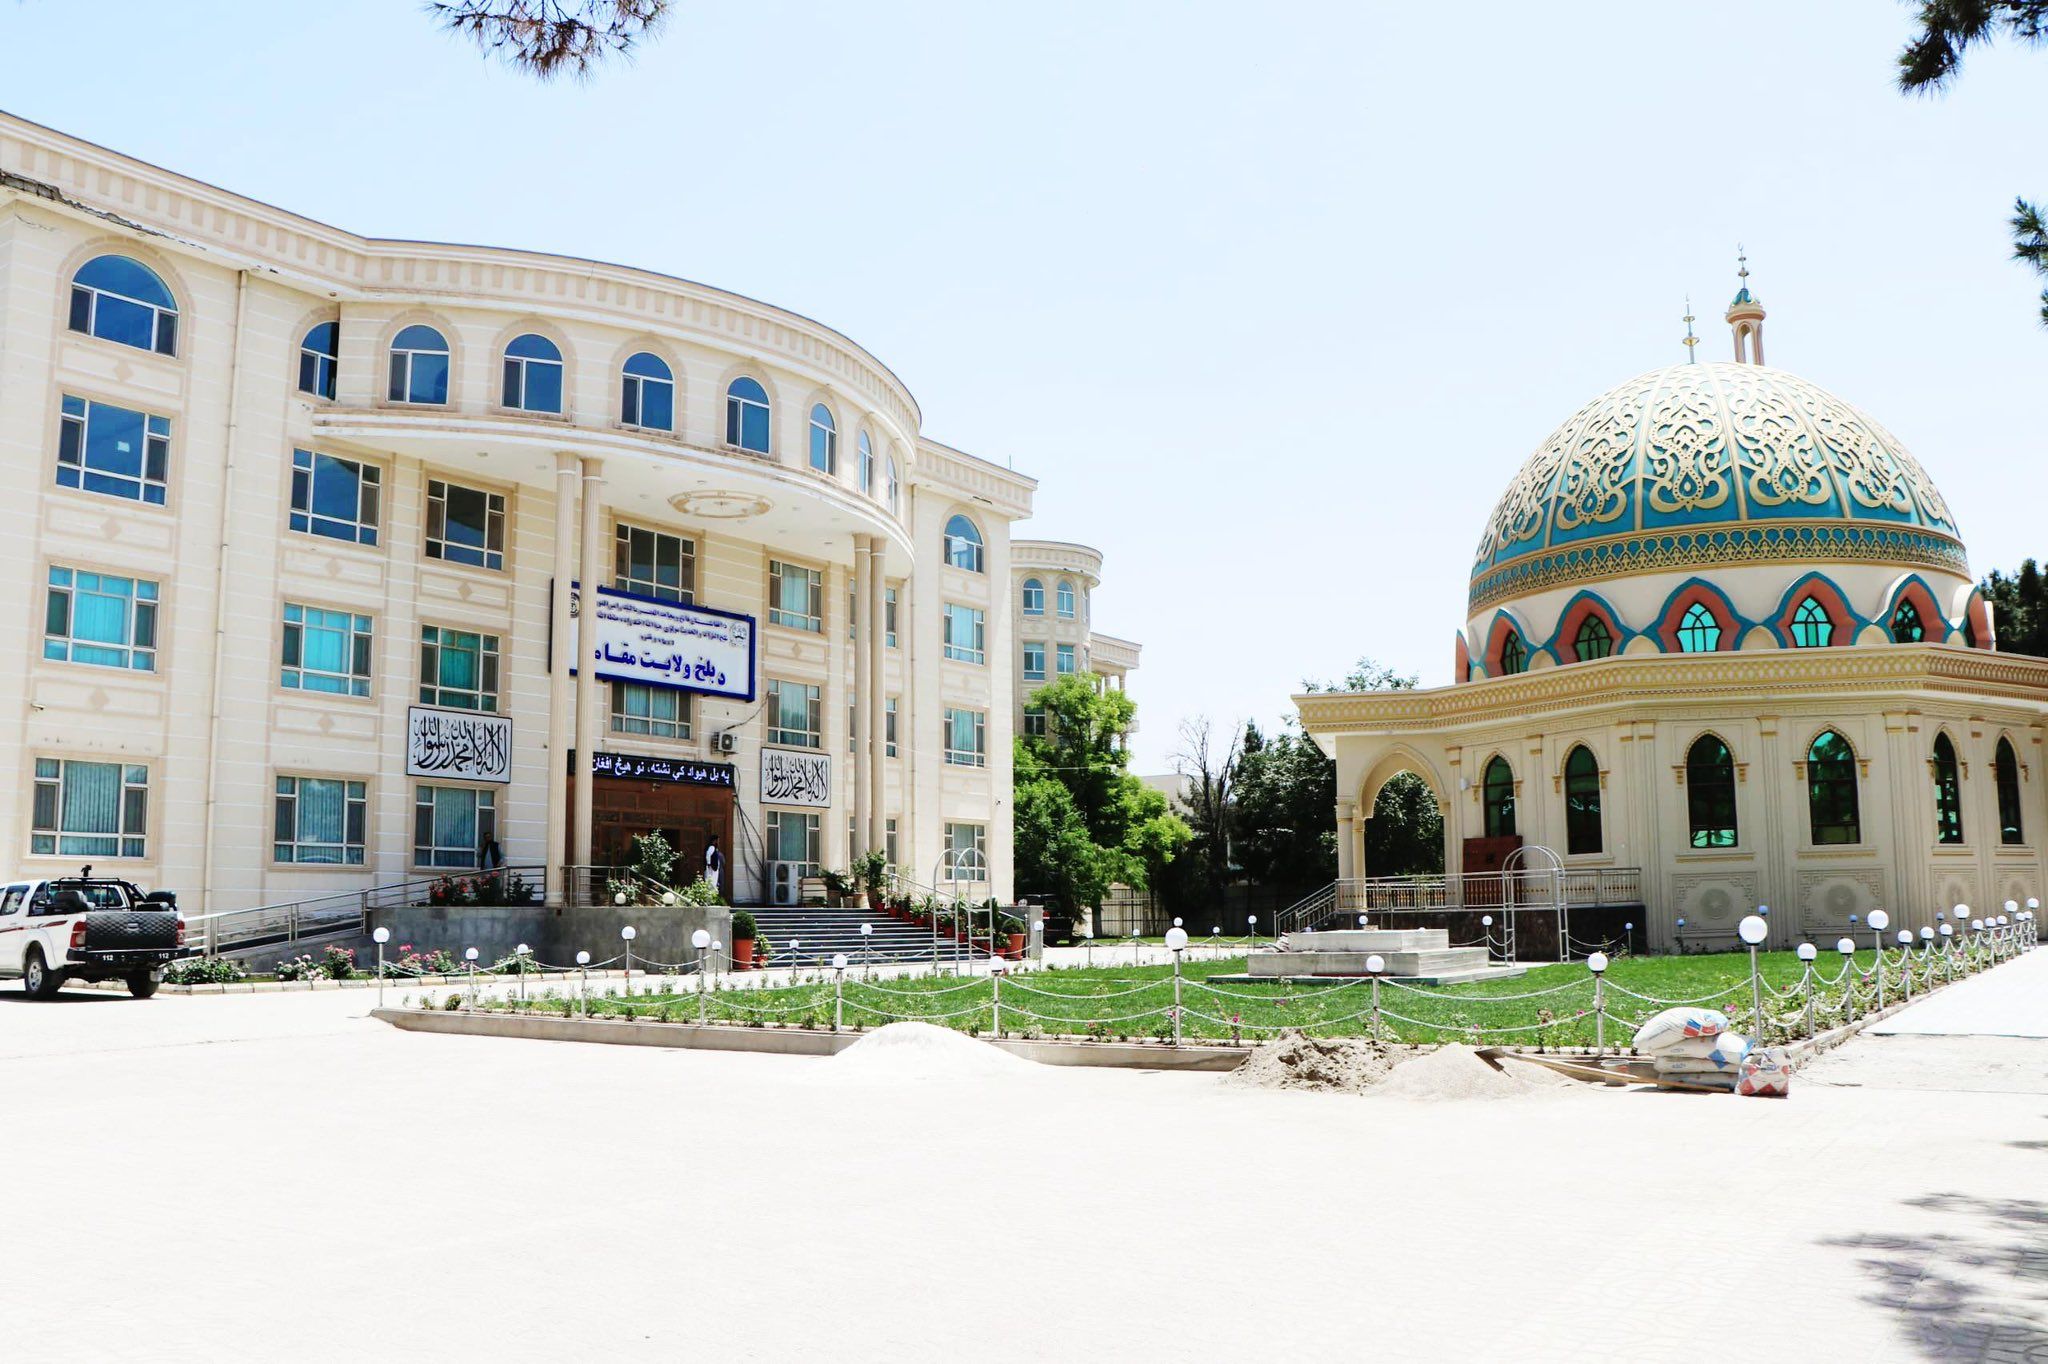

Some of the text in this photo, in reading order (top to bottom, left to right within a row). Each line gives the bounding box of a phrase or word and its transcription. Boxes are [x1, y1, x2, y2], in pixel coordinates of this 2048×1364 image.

[694, 657, 716, 684] بلخ
[718, 672, 726, 685] د
[634, 761, 645, 775] نو
[709, 767, 719, 781] بل
[721, 770, 730, 784] په
